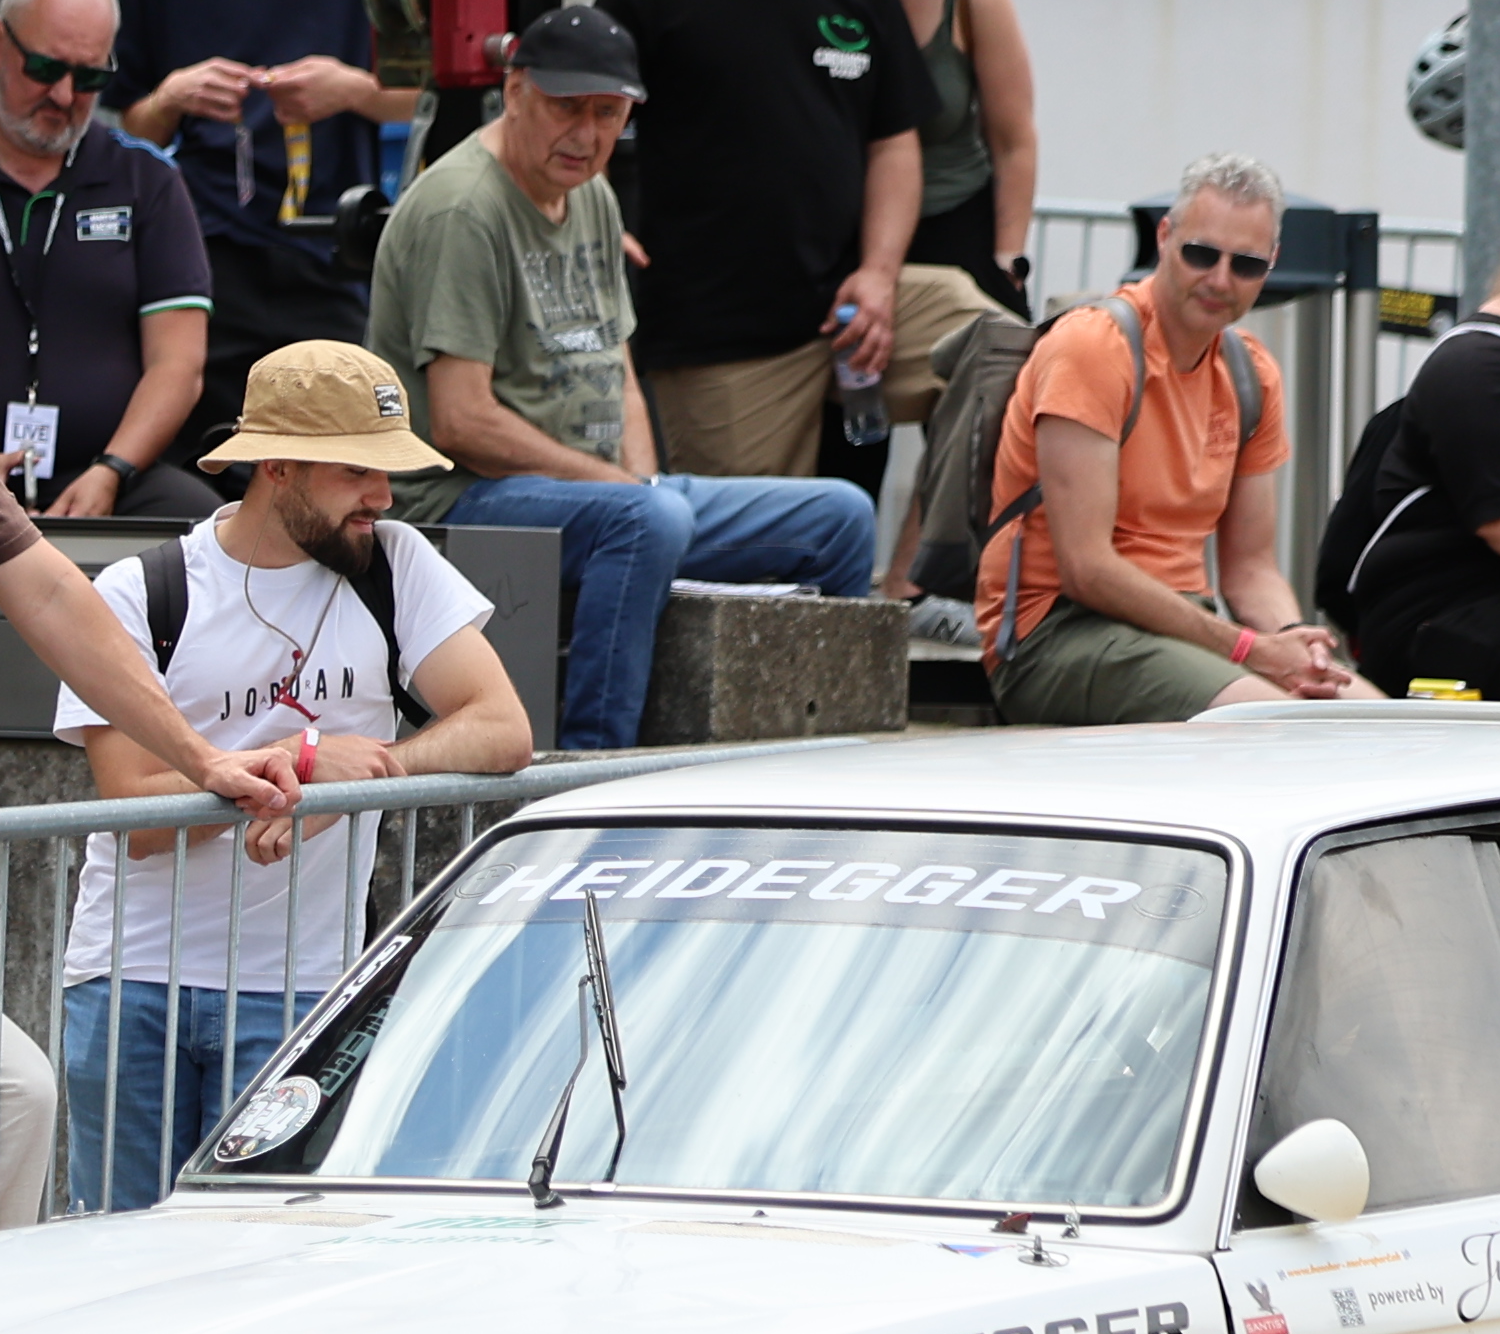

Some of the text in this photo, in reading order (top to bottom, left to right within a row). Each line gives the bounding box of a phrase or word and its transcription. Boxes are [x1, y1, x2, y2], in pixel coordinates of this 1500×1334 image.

[480, 858, 1143, 921] HEIDEGGER
[1368, 1281, 1445, 1312] powered by
